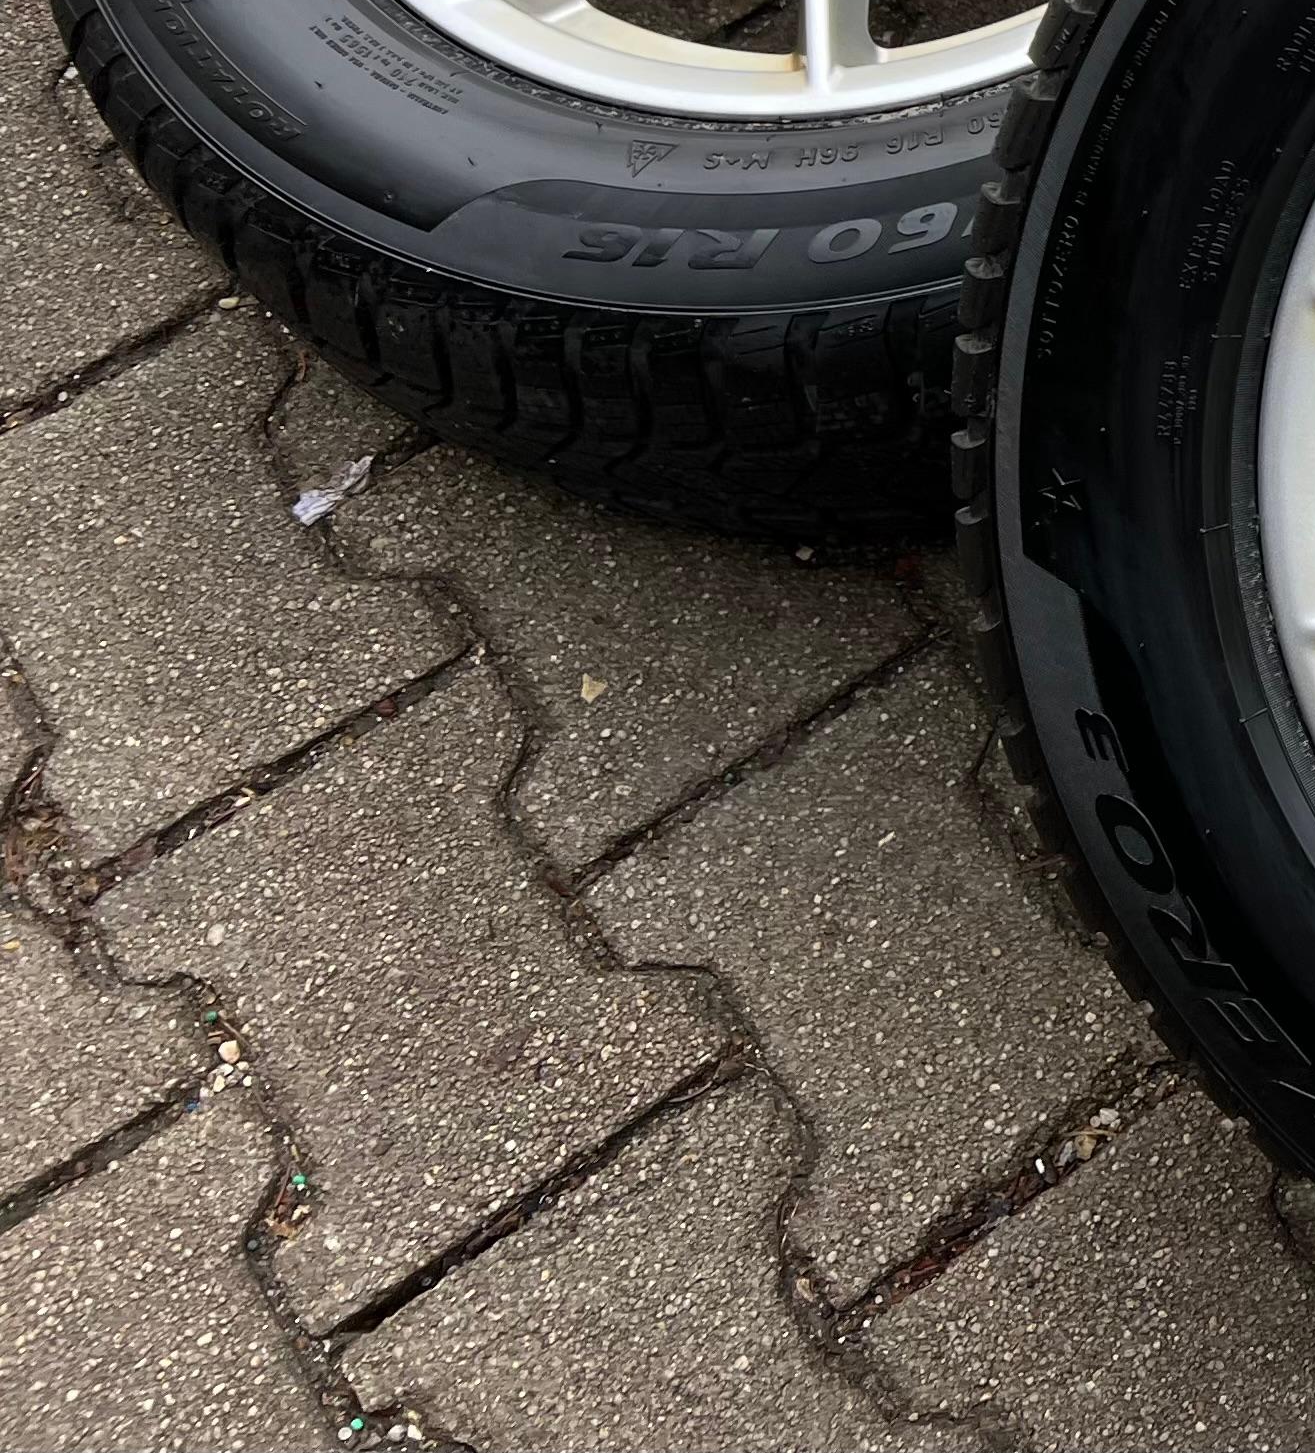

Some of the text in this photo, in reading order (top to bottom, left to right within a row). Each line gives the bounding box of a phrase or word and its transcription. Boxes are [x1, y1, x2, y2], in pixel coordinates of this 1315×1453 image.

[887, 128, 944, 155] R16
[562, 228, 780, 269] R16
[1179, 216, 1214, 293] EXTRA
